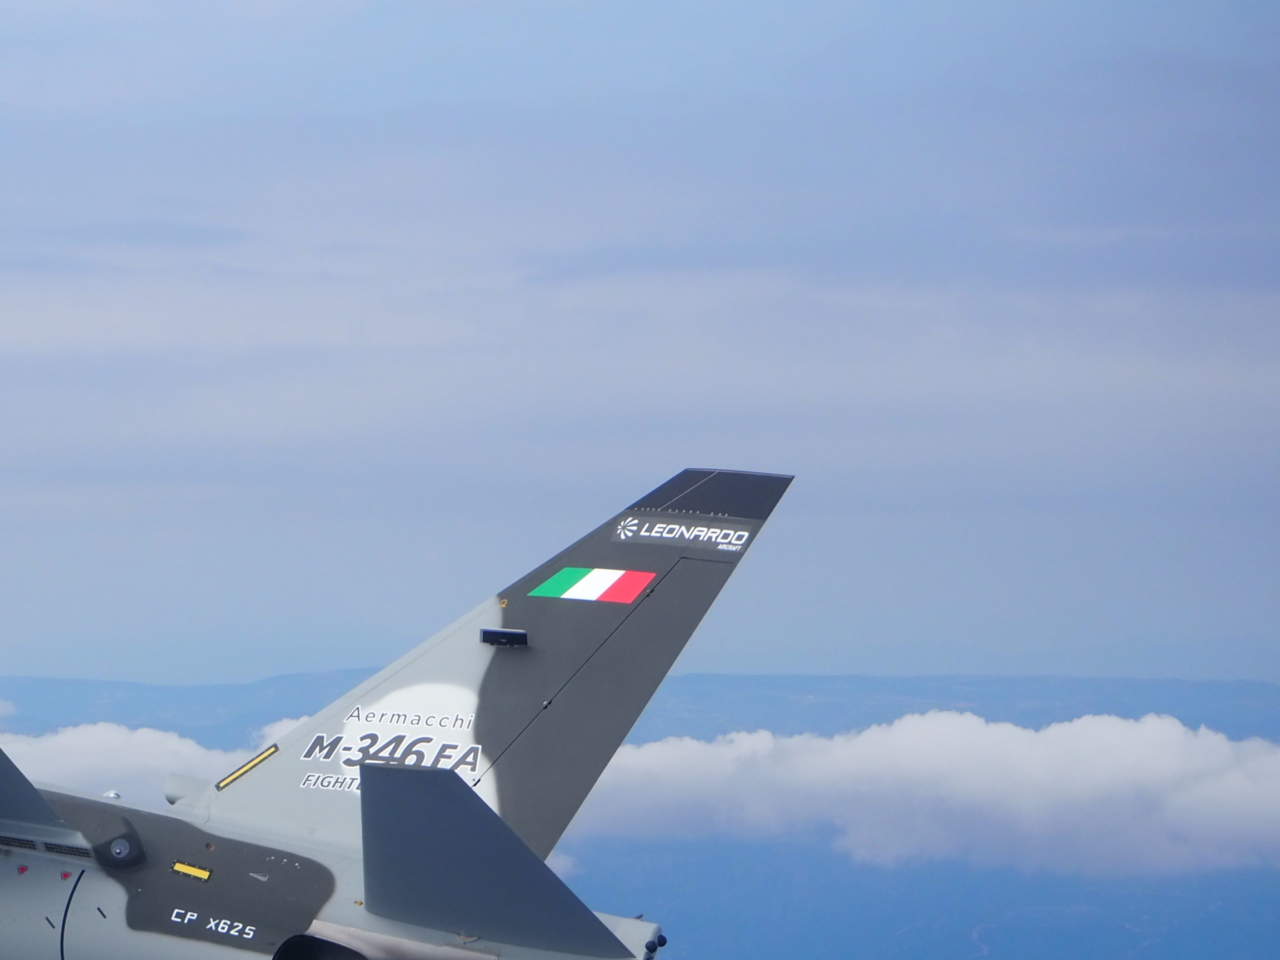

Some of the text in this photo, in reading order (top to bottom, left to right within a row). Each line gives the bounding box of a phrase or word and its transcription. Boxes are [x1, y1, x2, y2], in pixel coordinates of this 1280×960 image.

[639, 522, 749, 545] LEONARDO
[344, 705, 475, 731] Aermacchi
[170, 908, 256, 939] CP X625
